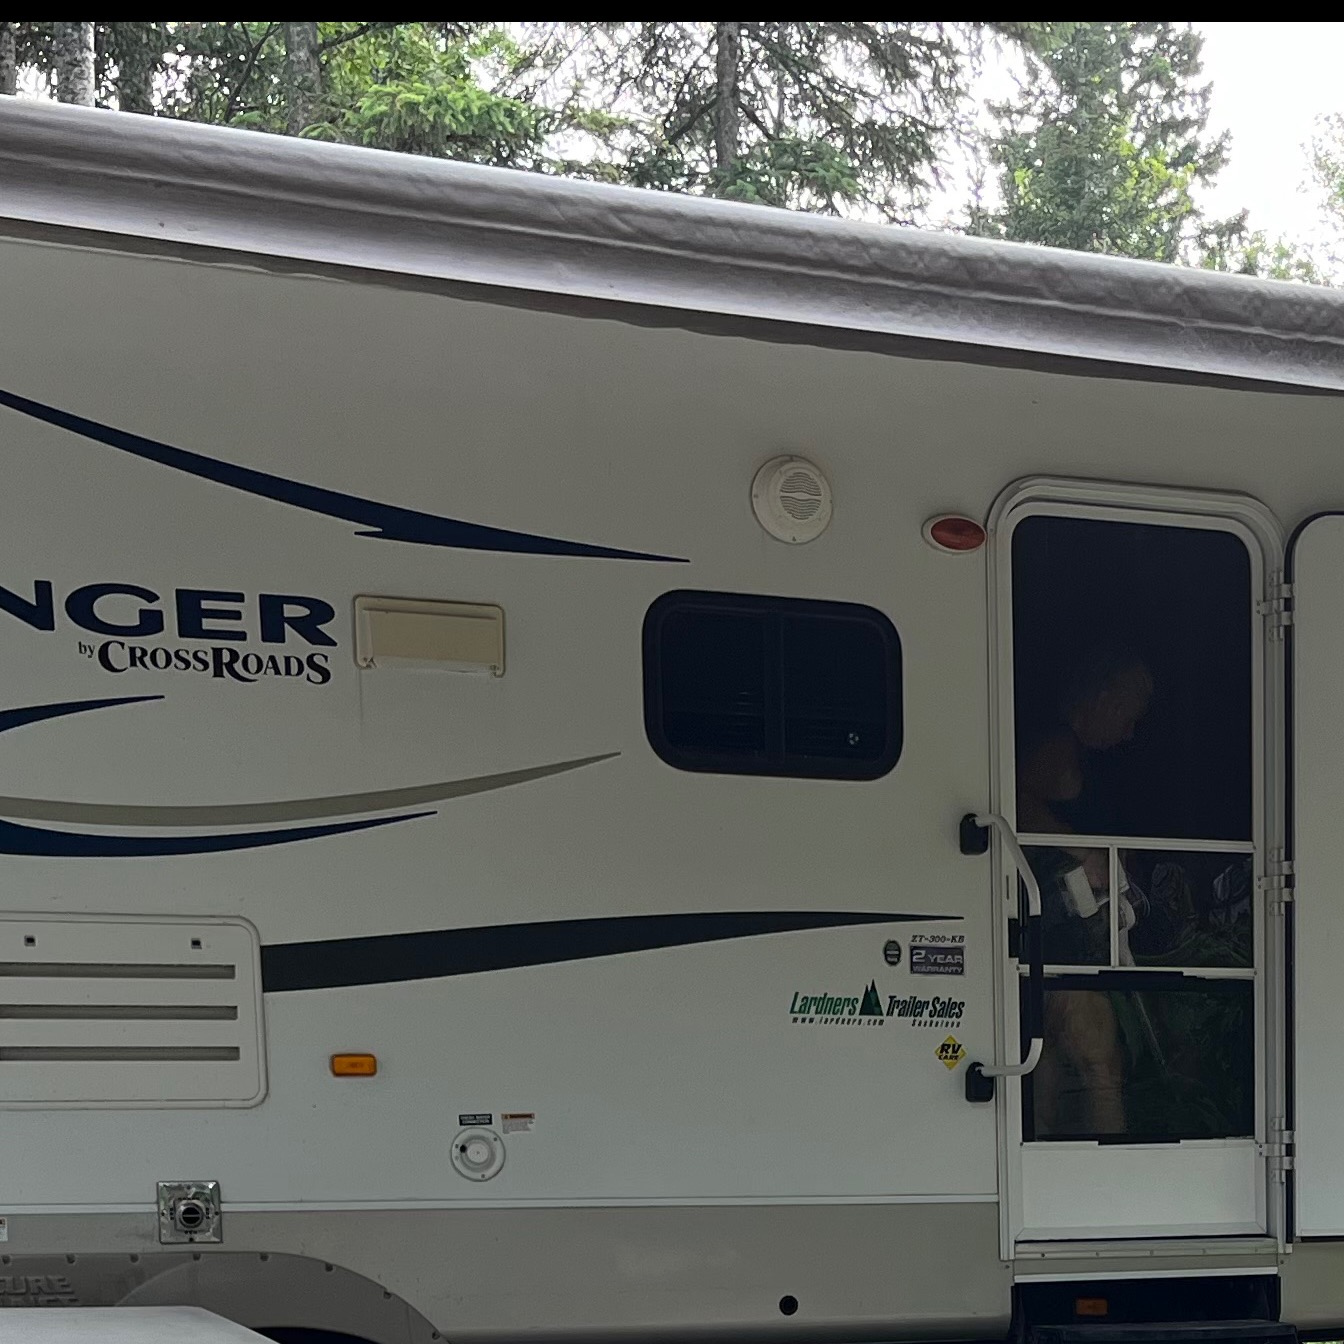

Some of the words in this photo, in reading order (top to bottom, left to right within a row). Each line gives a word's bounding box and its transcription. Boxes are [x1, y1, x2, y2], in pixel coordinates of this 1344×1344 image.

[78, 641, 96, 660] by
[912, 949, 926, 963] 2
[927, 954, 964, 964] YEAR
[912, 965, 963, 974] WARRANTY
[789, 991, 860, 1017] Lardners
[886, 994, 931, 1018] Trailer
[928, 995, 966, 1020] Sales
[939, 1043, 963, 1055] RV
